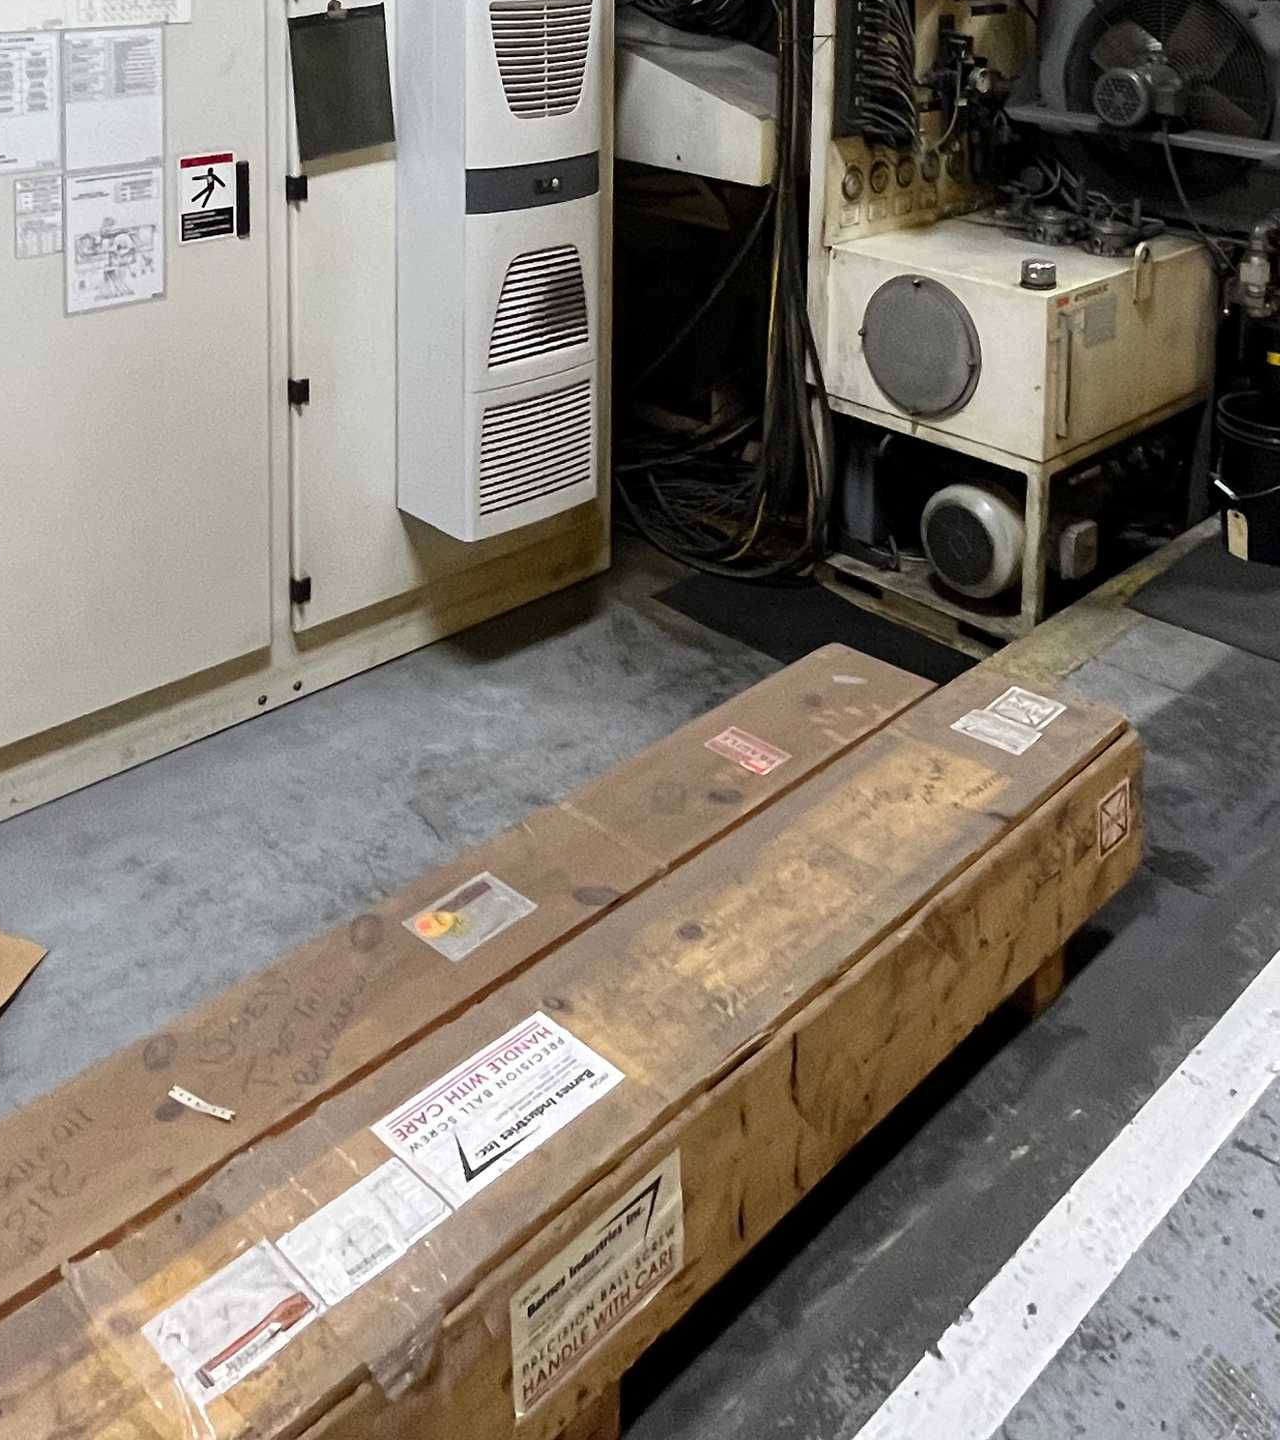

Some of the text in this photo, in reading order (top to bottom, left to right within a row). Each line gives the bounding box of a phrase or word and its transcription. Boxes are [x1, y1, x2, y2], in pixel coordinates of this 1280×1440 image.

[486, 1026, 553, 1074] HANDLE
[496, 1036, 565, 1088] PRECISION
[444, 1072, 489, 1105] WITH
[459, 1089, 494, 1114] BALL
[555, 1068, 595, 1098] Barnes
[391, 1103, 444, 1142] CARE
[409, 1115, 458, 1153] SCREW
[500, 1097, 558, 1140] Industries
[527, 1275, 566, 1318] Barnes
[569, 1223, 623, 1279] Industries
[522, 1299, 595, 1377] PRECISION
[600, 1269, 629, 1302] BALL
[635, 1222, 676, 1270] SCREW
[523, 1324, 588, 1399] HANDLE
[593, 1285, 631, 1331] WITH
[634, 1242, 675, 1290] CARE
